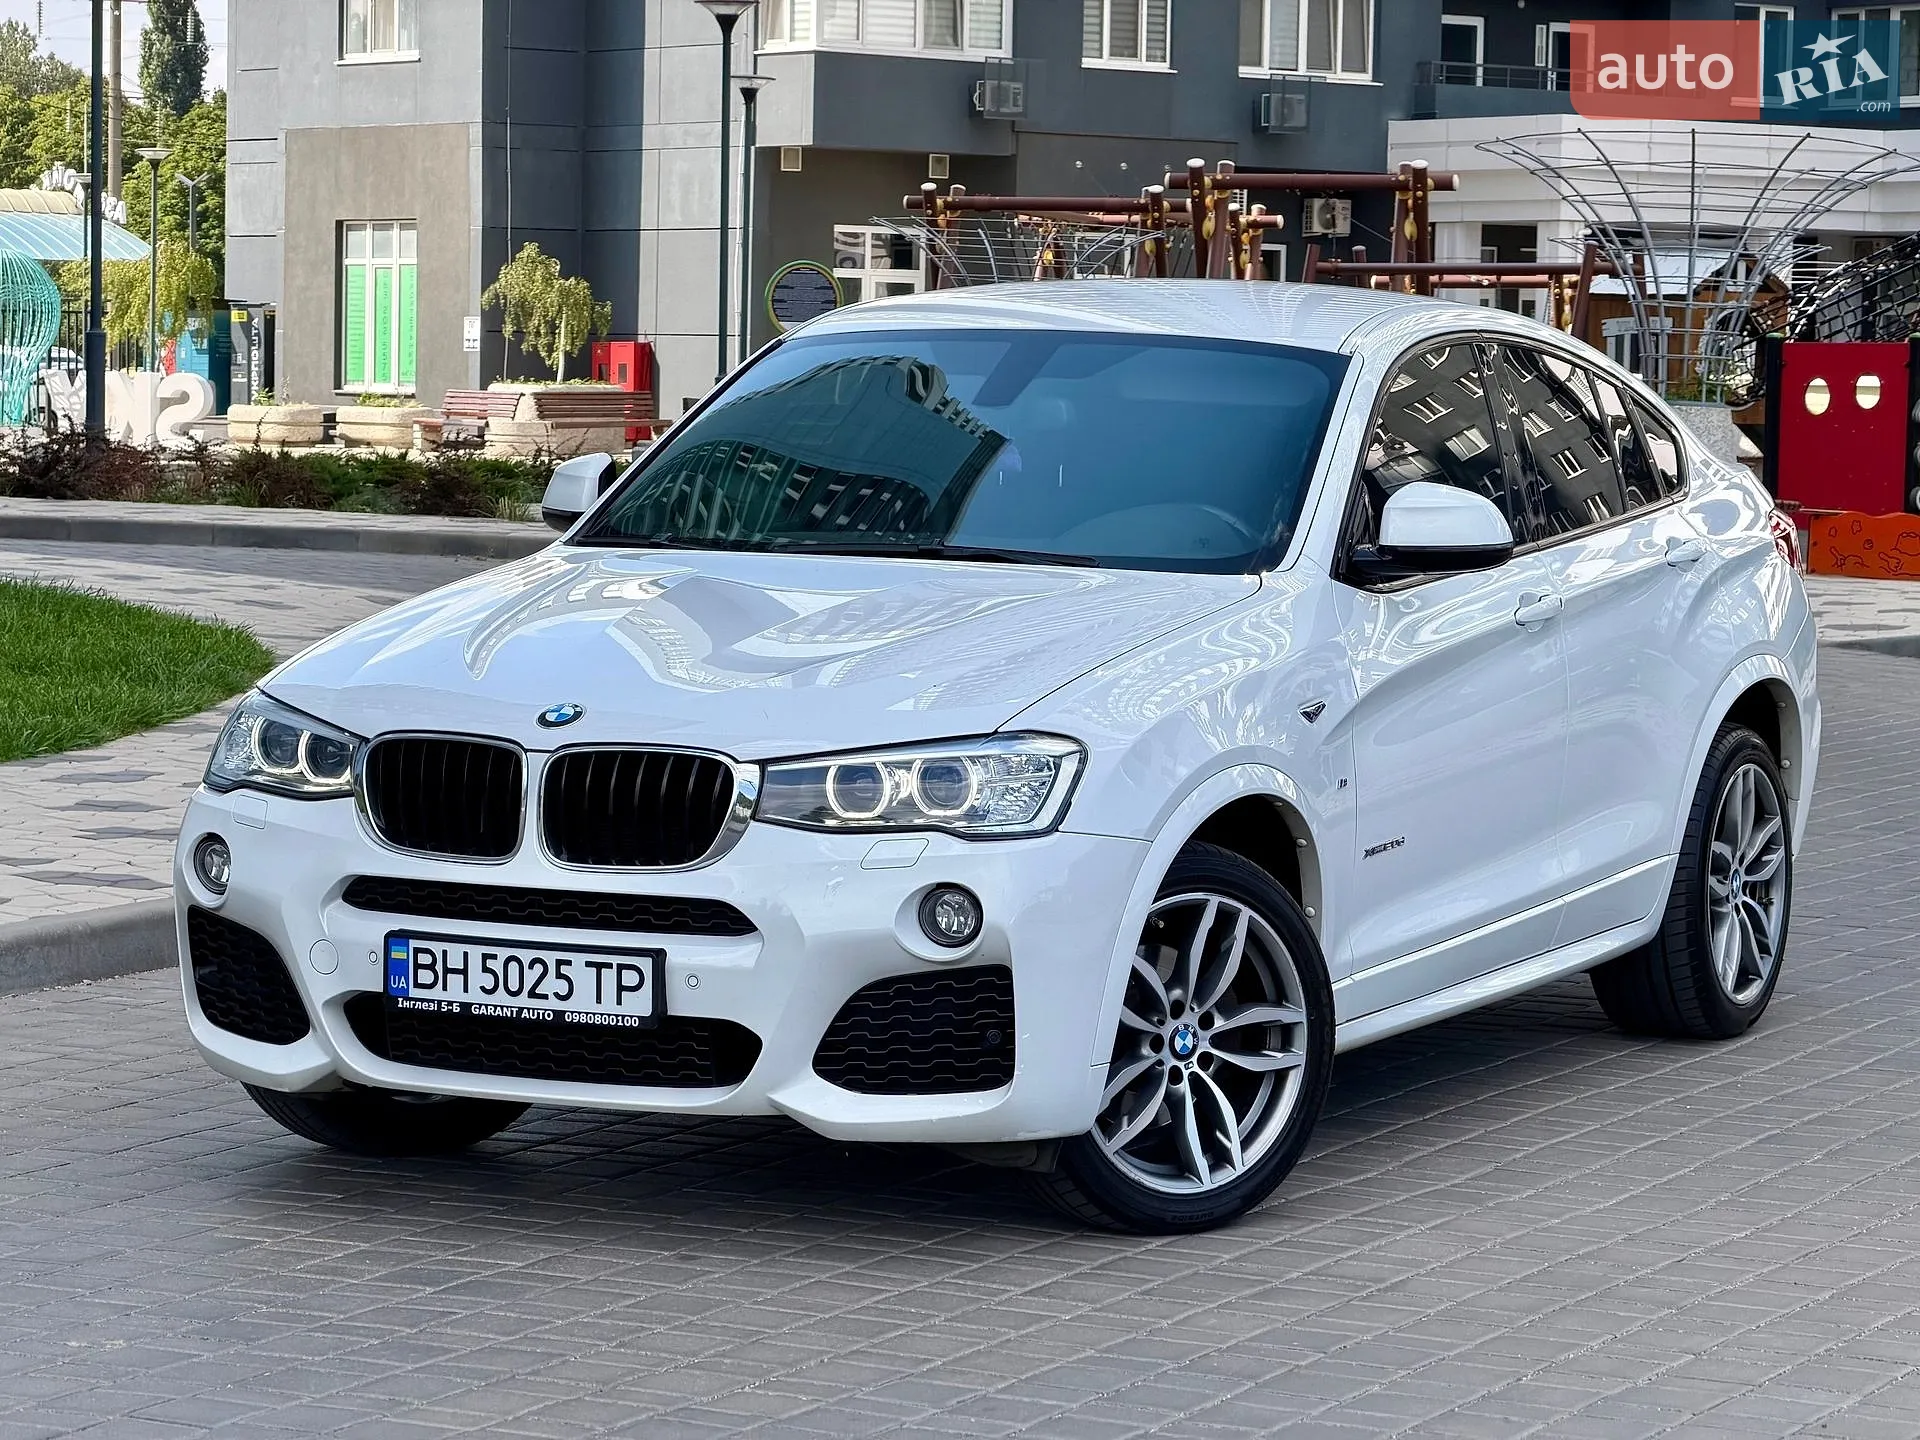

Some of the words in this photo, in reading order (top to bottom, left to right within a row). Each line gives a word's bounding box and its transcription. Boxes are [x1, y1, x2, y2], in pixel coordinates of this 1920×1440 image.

[390, 974, 408, 990] UA
[412, 946, 470, 994] BH
[479, 952, 575, 1002] 5025
[584, 960, 646, 1006] TP
[397, 997, 438, 1011] Інглезі
[440, 1001, 461, 1013] 5-Б
[471, 1003, 519, 1018] GARANT
[521, 1008, 554, 1021] AUTO
[564, 1011, 640, 1027] 0980800100
